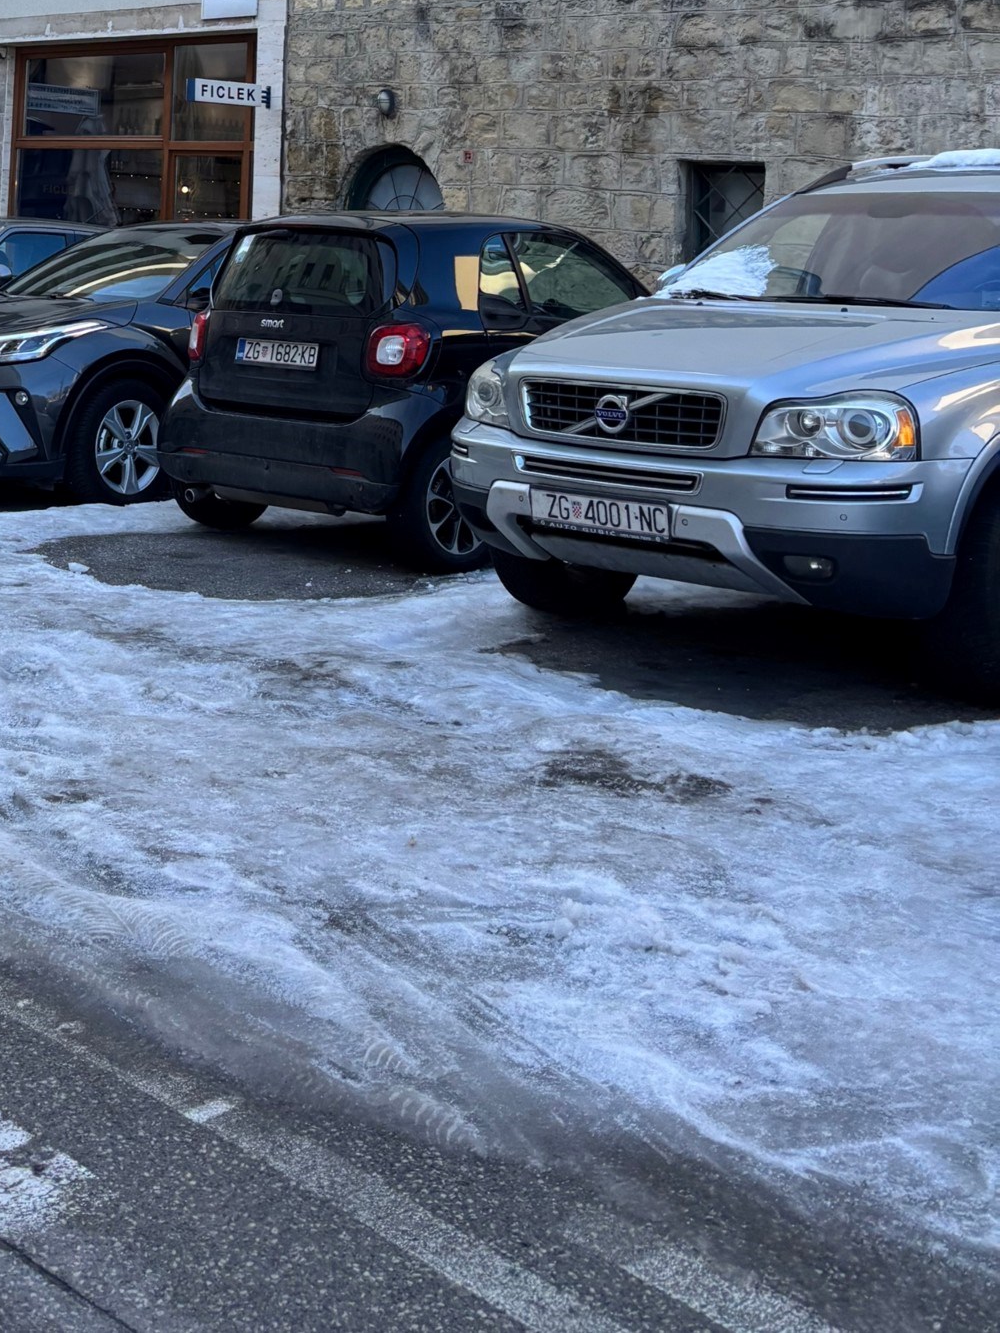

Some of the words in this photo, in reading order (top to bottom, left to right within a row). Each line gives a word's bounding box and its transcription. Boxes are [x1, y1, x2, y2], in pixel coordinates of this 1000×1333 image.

[200, 84, 256, 101] FICLEK
[260, 319, 284, 328] smart
[245, 341, 261, 360] ZG
[596, 410, 625, 419] VOLVO
[545, 494, 570, 520] ZG
[550, 521, 577, 531] AUTO
